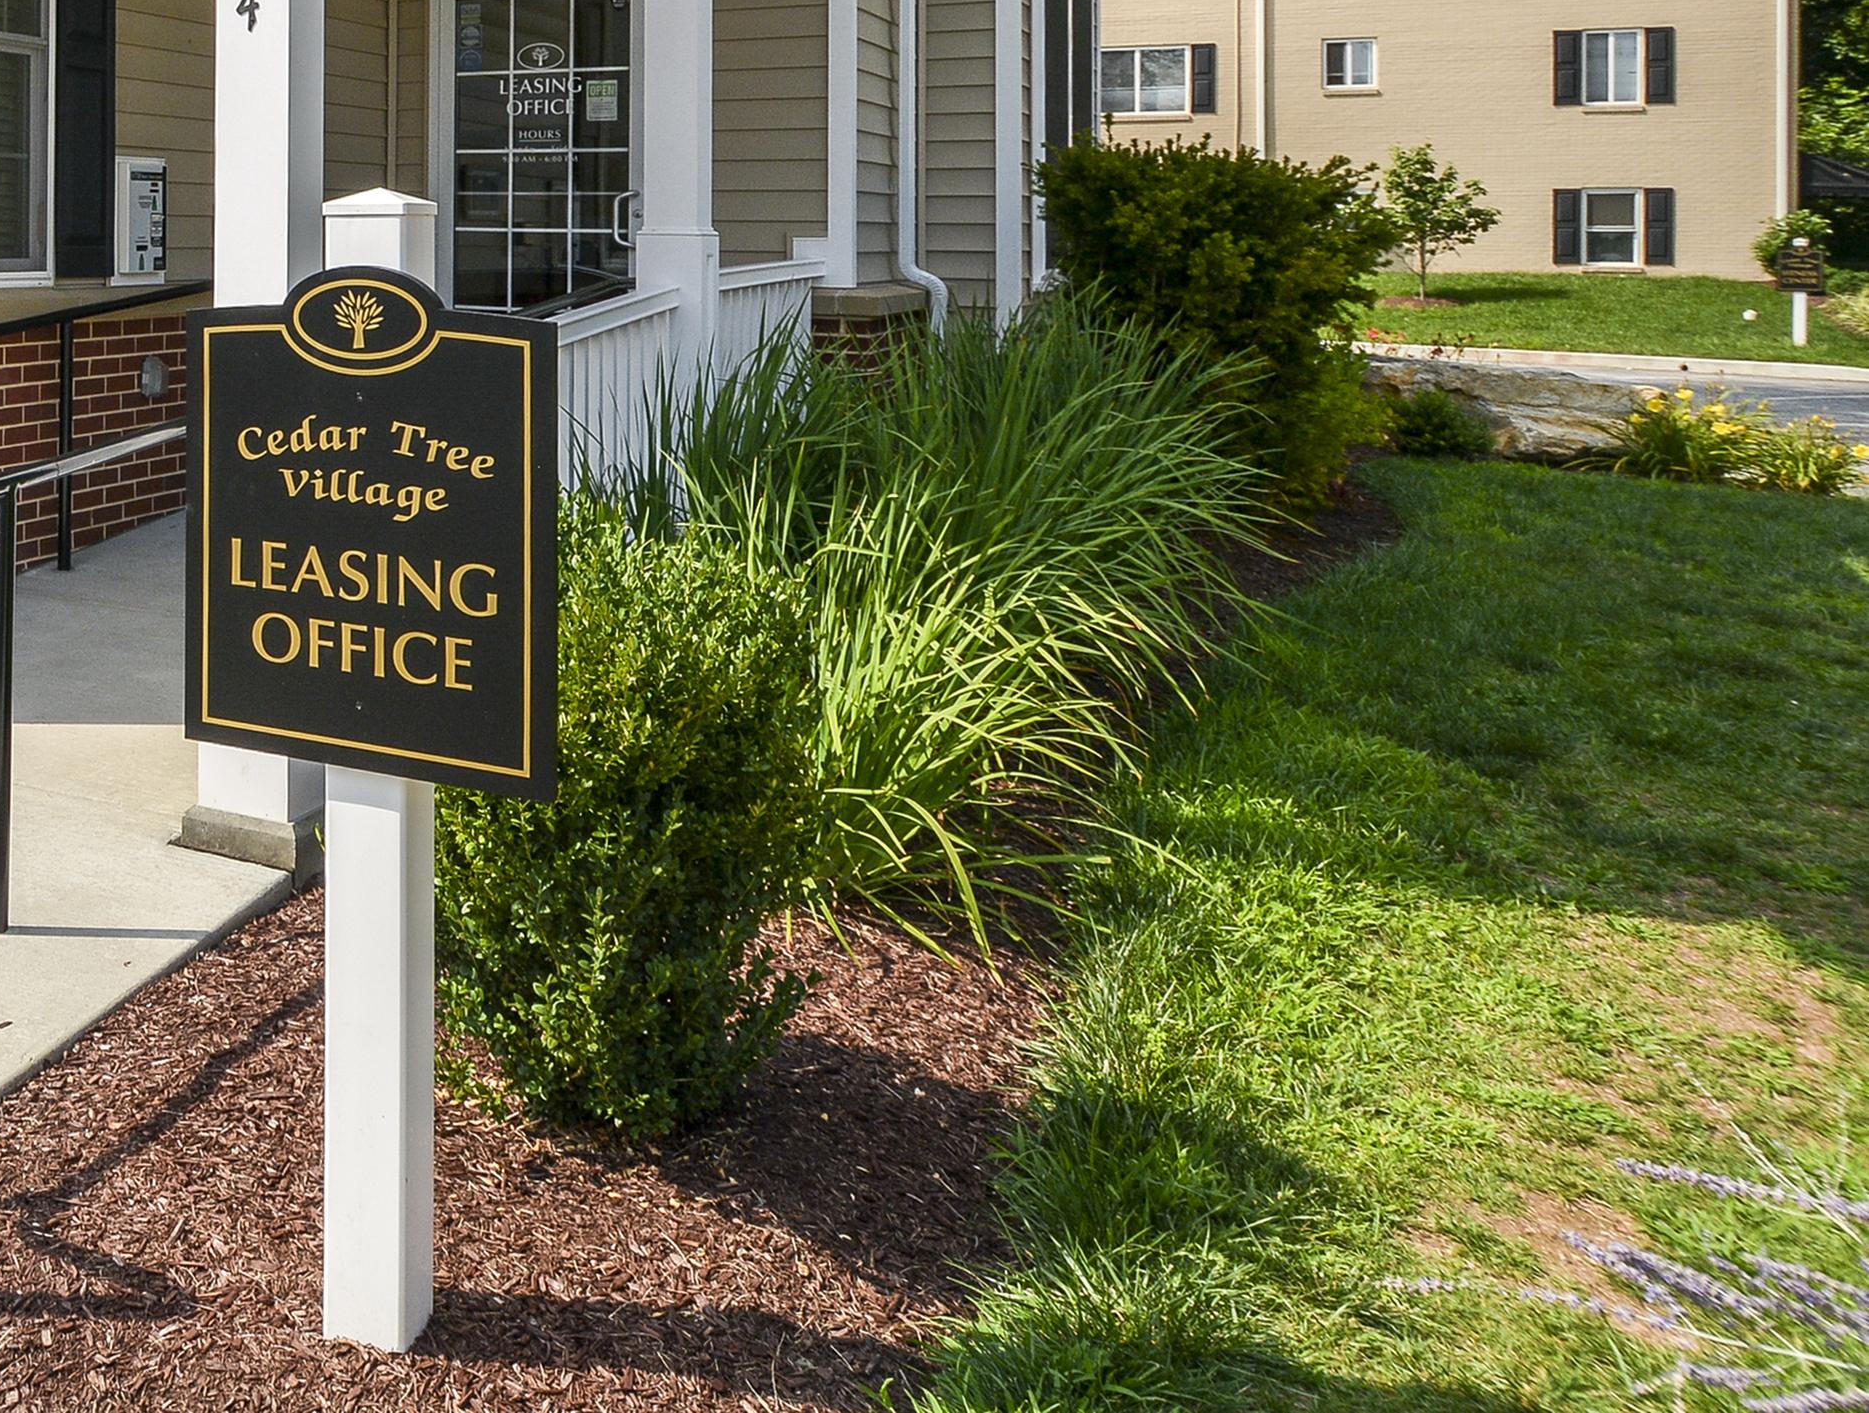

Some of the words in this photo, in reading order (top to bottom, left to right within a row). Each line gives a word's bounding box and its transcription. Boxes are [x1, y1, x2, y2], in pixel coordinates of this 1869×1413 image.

[499, 77, 582, 95] LEASING
[589, 85, 615, 96] OPEN
[506, 98, 574, 116] OFFICE
[518, 129, 561, 139] HOURS
[237, 415, 369, 461] Cedar
[390, 420, 496, 479] Tree
[278, 468, 449, 522] Village
[230, 536, 499, 618] LEASING
[251, 612, 474, 692] OFFICE
